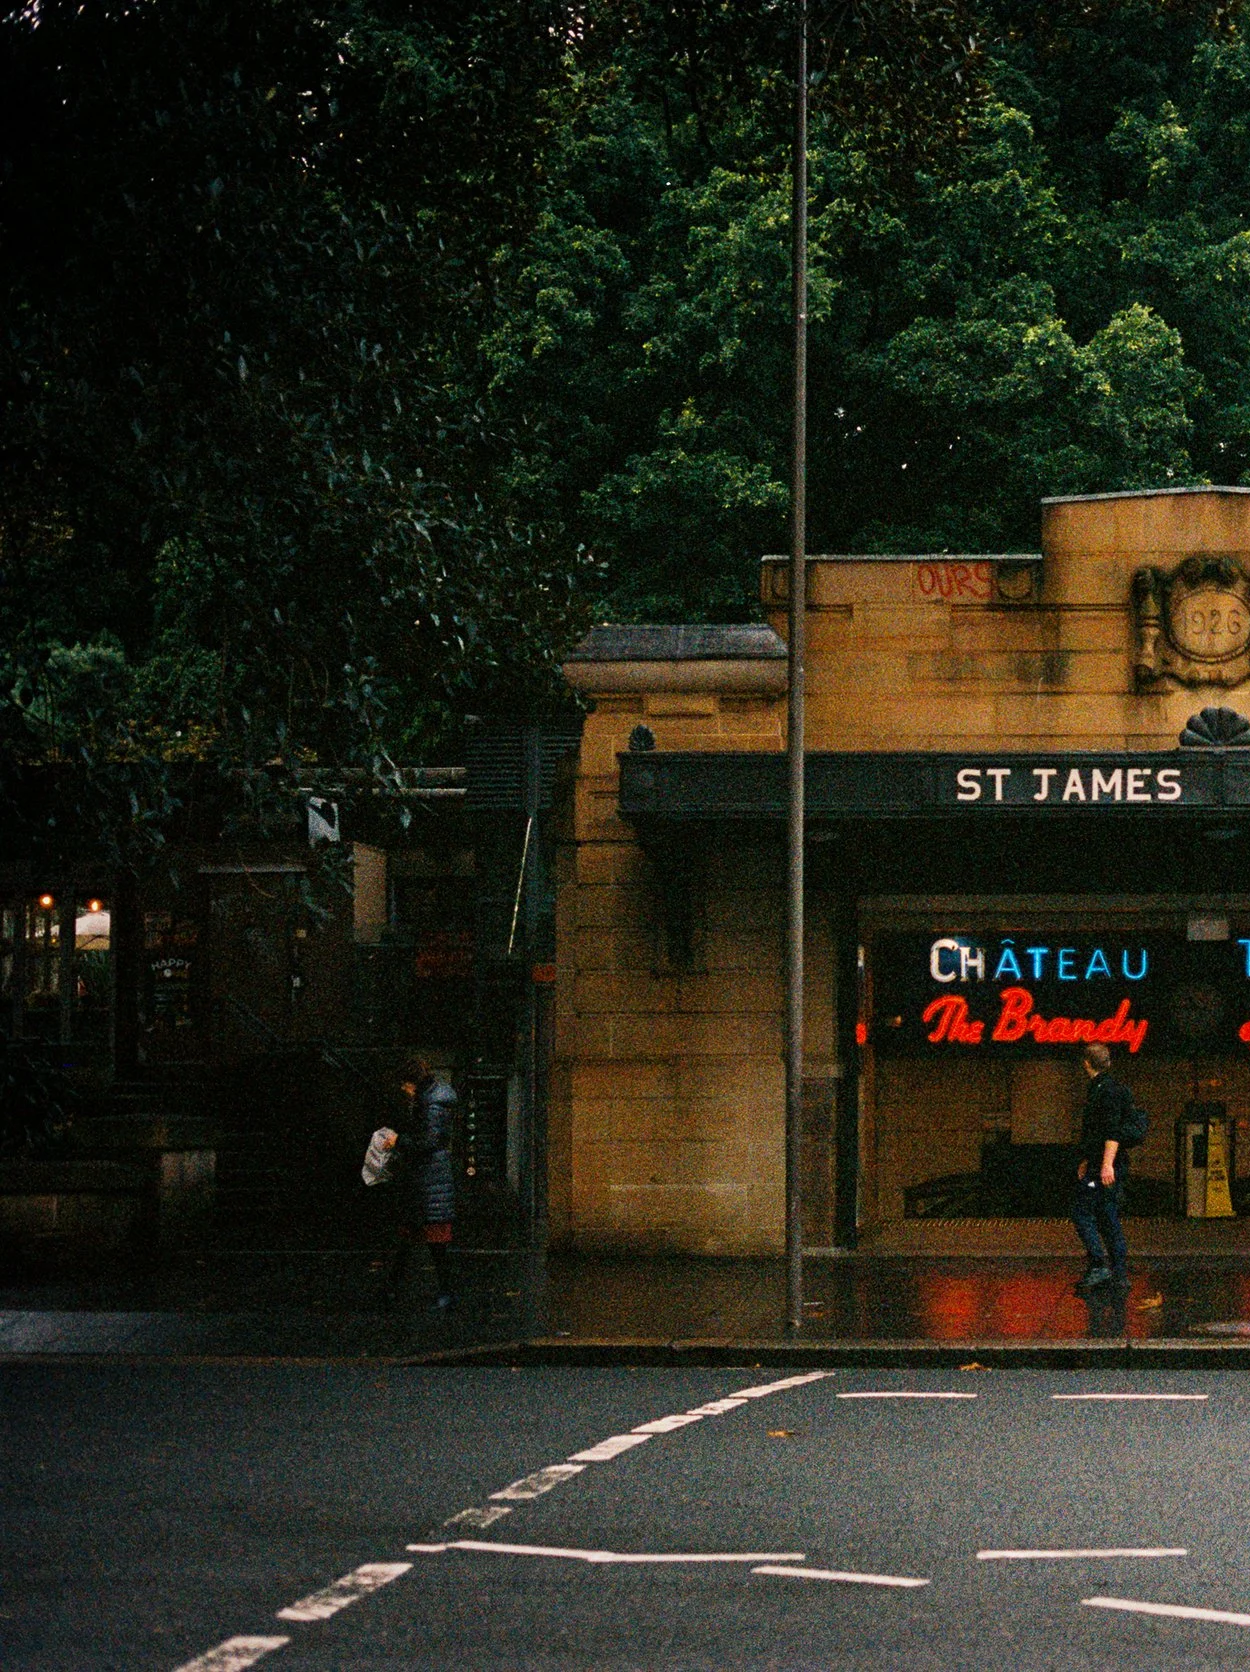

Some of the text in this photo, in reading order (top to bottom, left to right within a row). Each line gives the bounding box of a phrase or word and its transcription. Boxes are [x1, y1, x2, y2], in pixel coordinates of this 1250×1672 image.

[957, 768, 1011, 801] ST
[1034, 768, 1182, 801] JAMES
[151, 958, 192, 971] HAPPY
[930, 938, 1148, 982] CHÂTEAU
[923, 995, 985, 1042] The
[991, 987, 1149, 1053] Brandy
